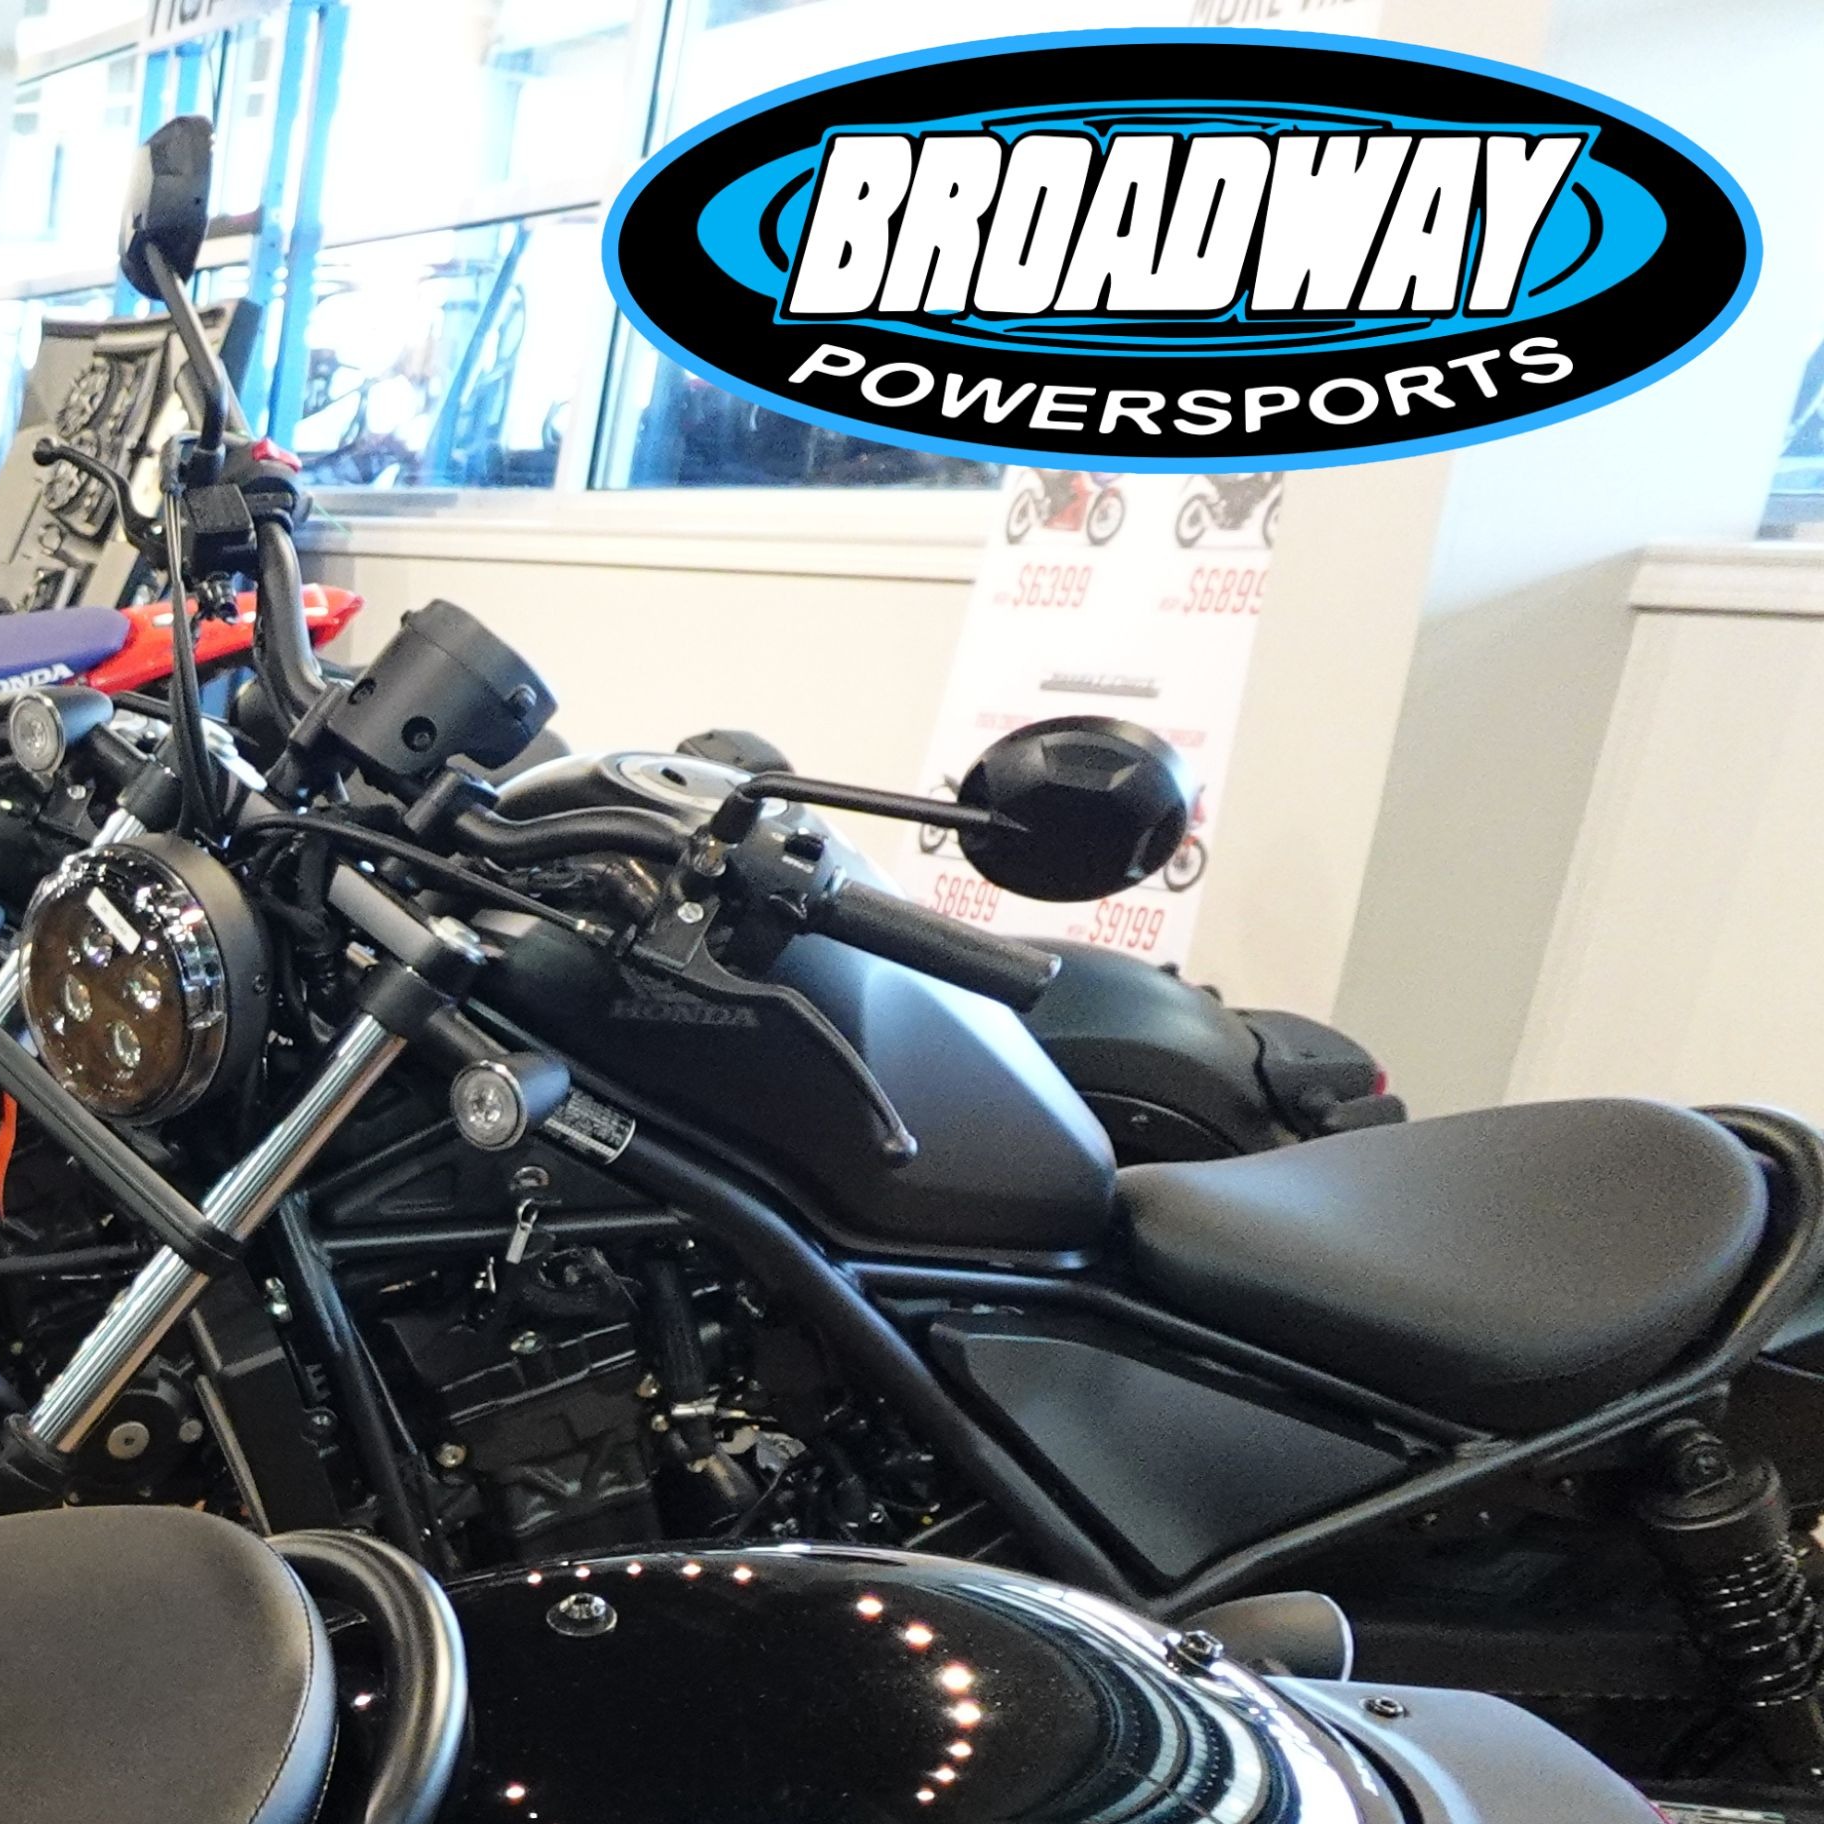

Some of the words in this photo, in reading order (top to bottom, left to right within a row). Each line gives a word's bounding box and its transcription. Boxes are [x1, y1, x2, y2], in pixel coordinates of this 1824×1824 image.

[1013, 565, 1092, 609] $6399
[1182, 568, 1267, 617] $6899
[930, 873, 1001, 923] $8699
[1088, 898, 1166, 952] $9199
